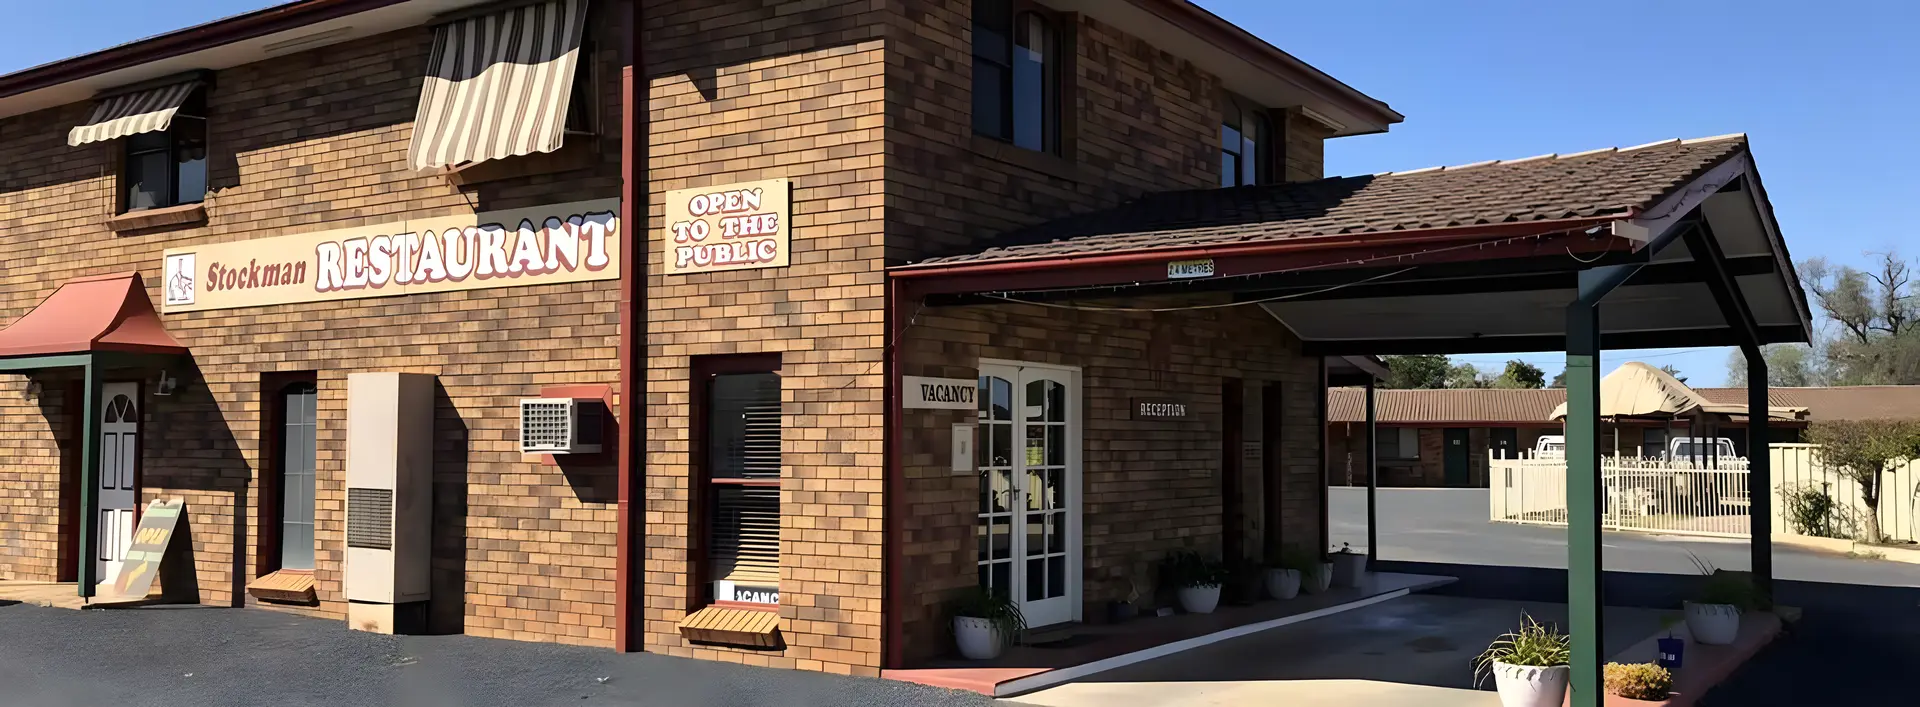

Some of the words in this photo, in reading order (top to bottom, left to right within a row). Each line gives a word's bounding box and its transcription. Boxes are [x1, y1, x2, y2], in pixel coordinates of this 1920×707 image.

[688, 187, 763, 217] OPEN
[671, 218, 710, 243] TO
[718, 212, 779, 239] THE
[206, 258, 307, 292] Stockman
[315, 210, 616, 293] RESTAURANT
[675, 239, 777, 268] PUBLIC
[921, 383, 975, 403] VACANCY
[1140, 402, 1187, 417] RECEPTION
